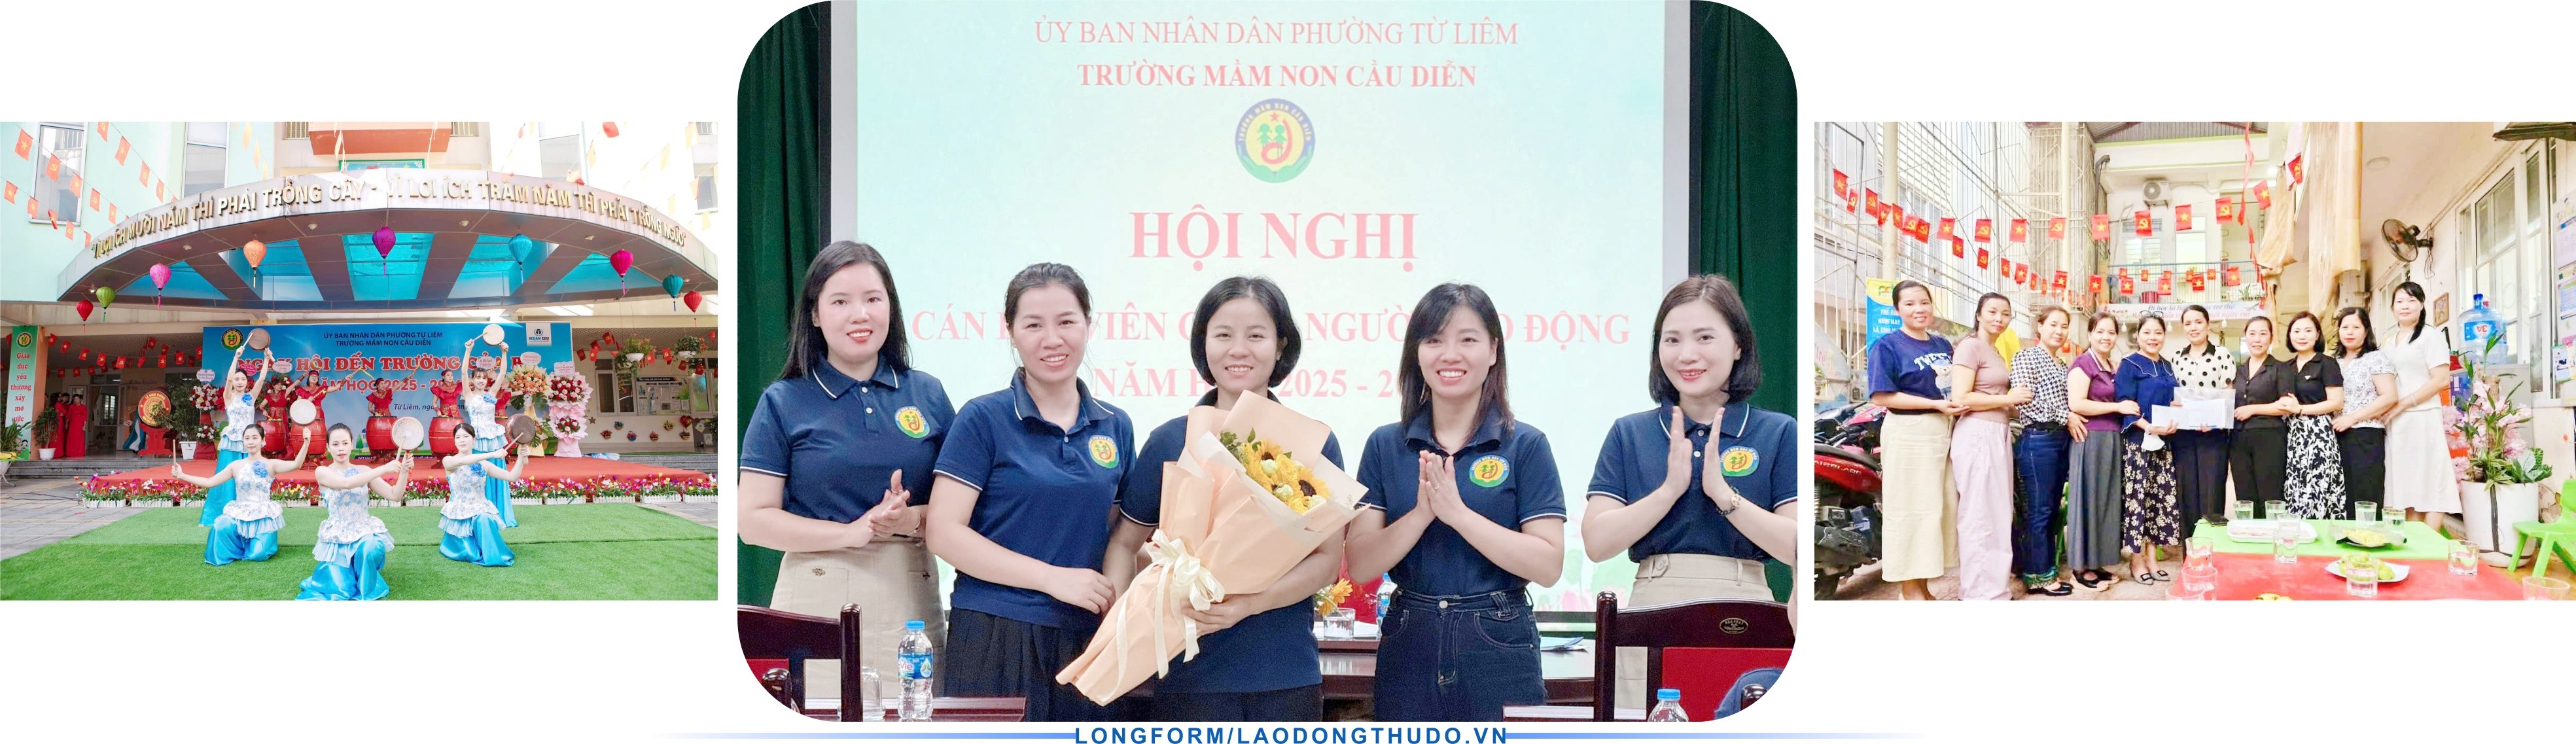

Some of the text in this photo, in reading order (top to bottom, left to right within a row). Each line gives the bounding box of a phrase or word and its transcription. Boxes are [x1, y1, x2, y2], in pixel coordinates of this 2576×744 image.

[1034, 16, 1518, 44] ỦY BAN NHÂN DÂN PHƯỜNG TỪ LIÊM
[1078, 59, 1477, 88] TRƯỜNG MẦM NON CẦU DIỄN
[191, 196, 214, 221] THÌ
[218, 188, 256, 216] PHẢI
[328, 179, 365, 202] CÂY
[478, 177, 529, 204] TRĂM
[532, 183, 571, 208] NĂM
[573, 191, 597, 213] THÌ
[599, 196, 629, 222] PHẢI
[1128, 204, 1419, 272] HỘI NGHỊ
[911, 303, 985, 340] CÁN
[1089, 302, 1168, 340] VIÊN
[1305, 305, 1411, 342] NGƯỜ
[1524, 310, 1631, 350] ĐỘNG
[17, 363, 28, 371] dục
[334, 351, 375, 371] ĐẾN
[381, 353, 461, 372] TRƯỜNG
[10, 383, 31, 392] thương
[16, 372, 27, 381] yêu
[1093, 361, 1178, 397] NĂM
[1278, 369, 1348, 398] 2025
